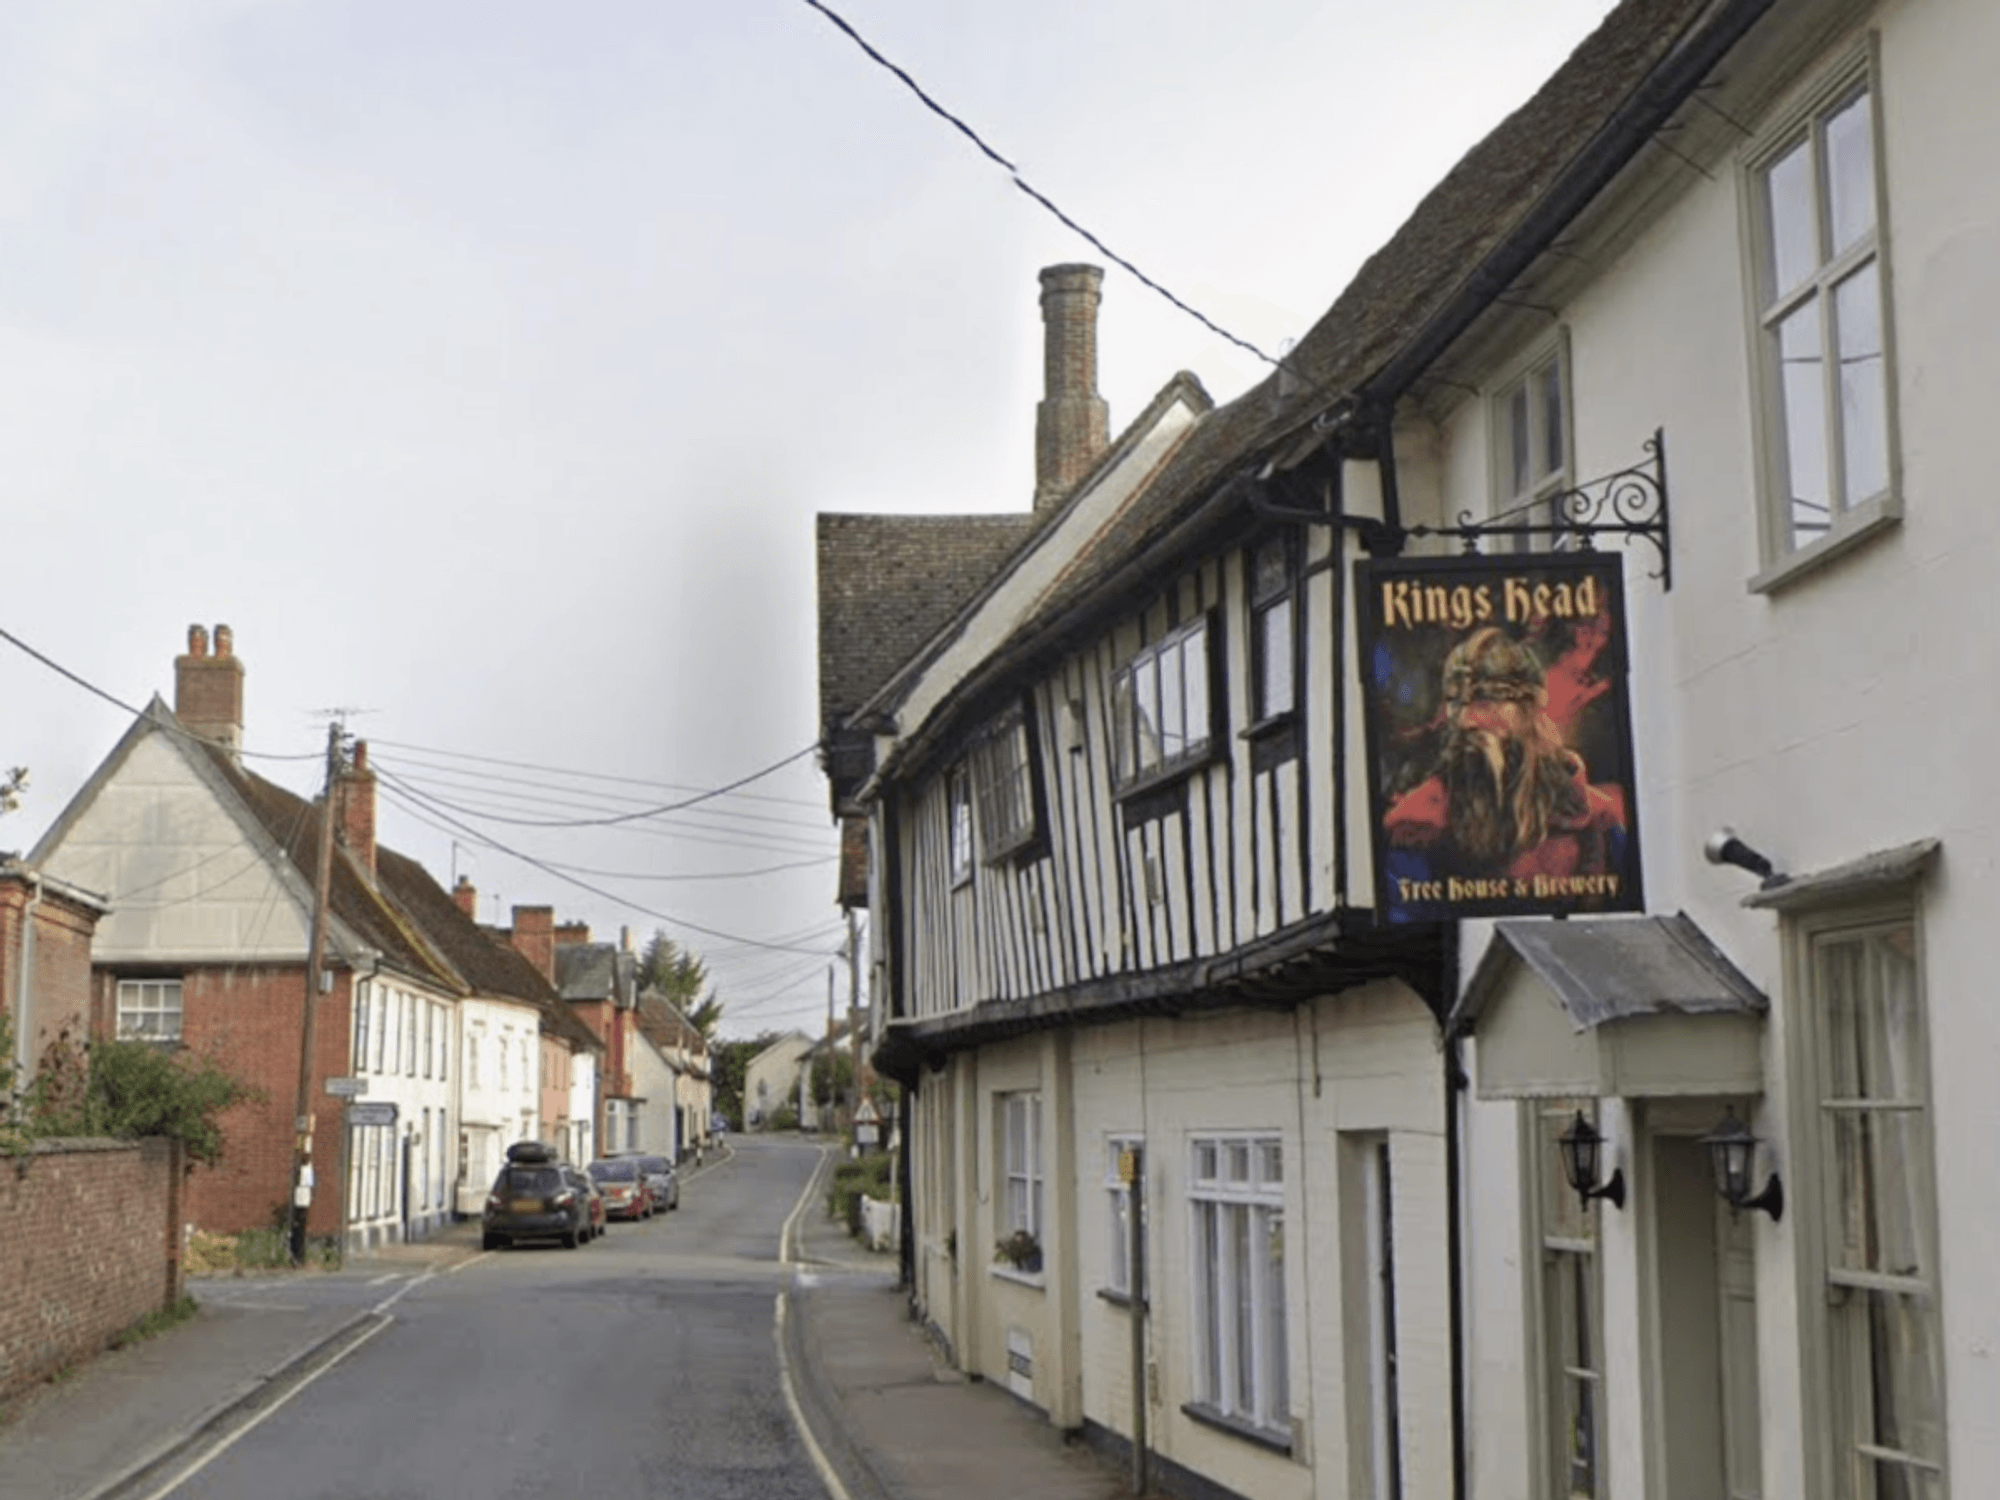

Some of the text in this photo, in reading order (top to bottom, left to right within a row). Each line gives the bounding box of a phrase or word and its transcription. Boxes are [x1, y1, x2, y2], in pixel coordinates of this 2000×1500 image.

[1383, 575, 1597, 630] Kings Head
[1399, 878, 1442, 901] Free
[1515, 879, 1528, 897] &
[1534, 874, 1619, 898] Brewery
